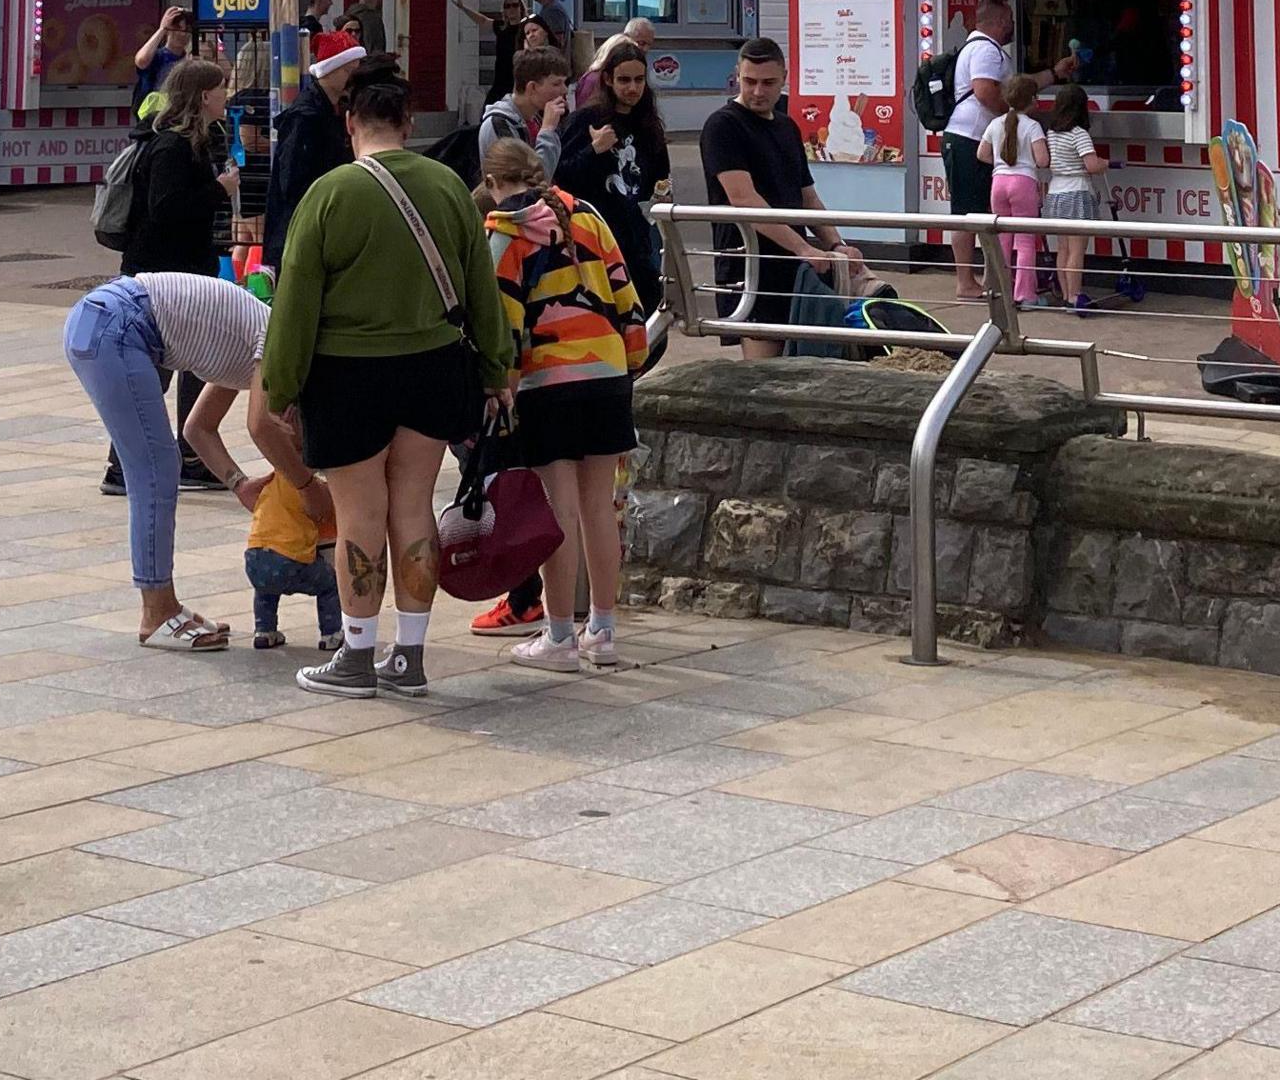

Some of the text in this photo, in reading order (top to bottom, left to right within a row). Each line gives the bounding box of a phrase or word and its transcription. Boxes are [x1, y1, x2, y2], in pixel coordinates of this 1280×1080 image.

[2, 140, 67, 158] HOT AND
[1114, 187, 1210, 216] SOFT ICE
